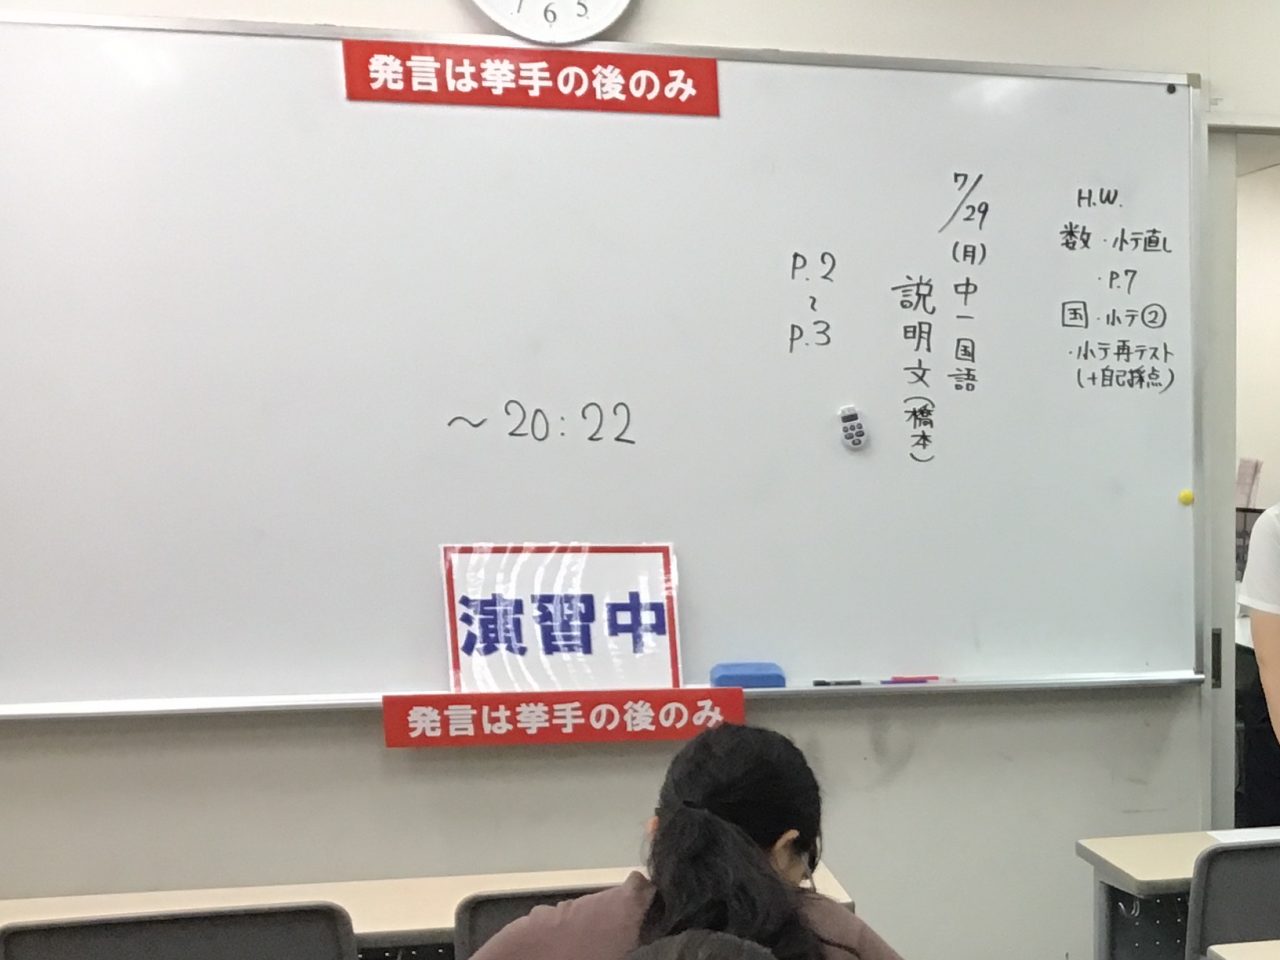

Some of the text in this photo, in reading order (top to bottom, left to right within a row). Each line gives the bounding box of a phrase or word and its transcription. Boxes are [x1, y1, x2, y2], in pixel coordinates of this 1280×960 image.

[543, 2, 557, 23] 6
[368, 53, 698, 102] 発言は挙手の後のみ
[938, 172, 989, 234] 7/29
[1077, 188, 1123, 208] H.W.
[791, 251, 836, 283] P.2
[789, 320, 831, 353] P.3
[459, 591, 667, 656] 演習中
[407, 698, 724, 738] 発言は挙手の後のみ
